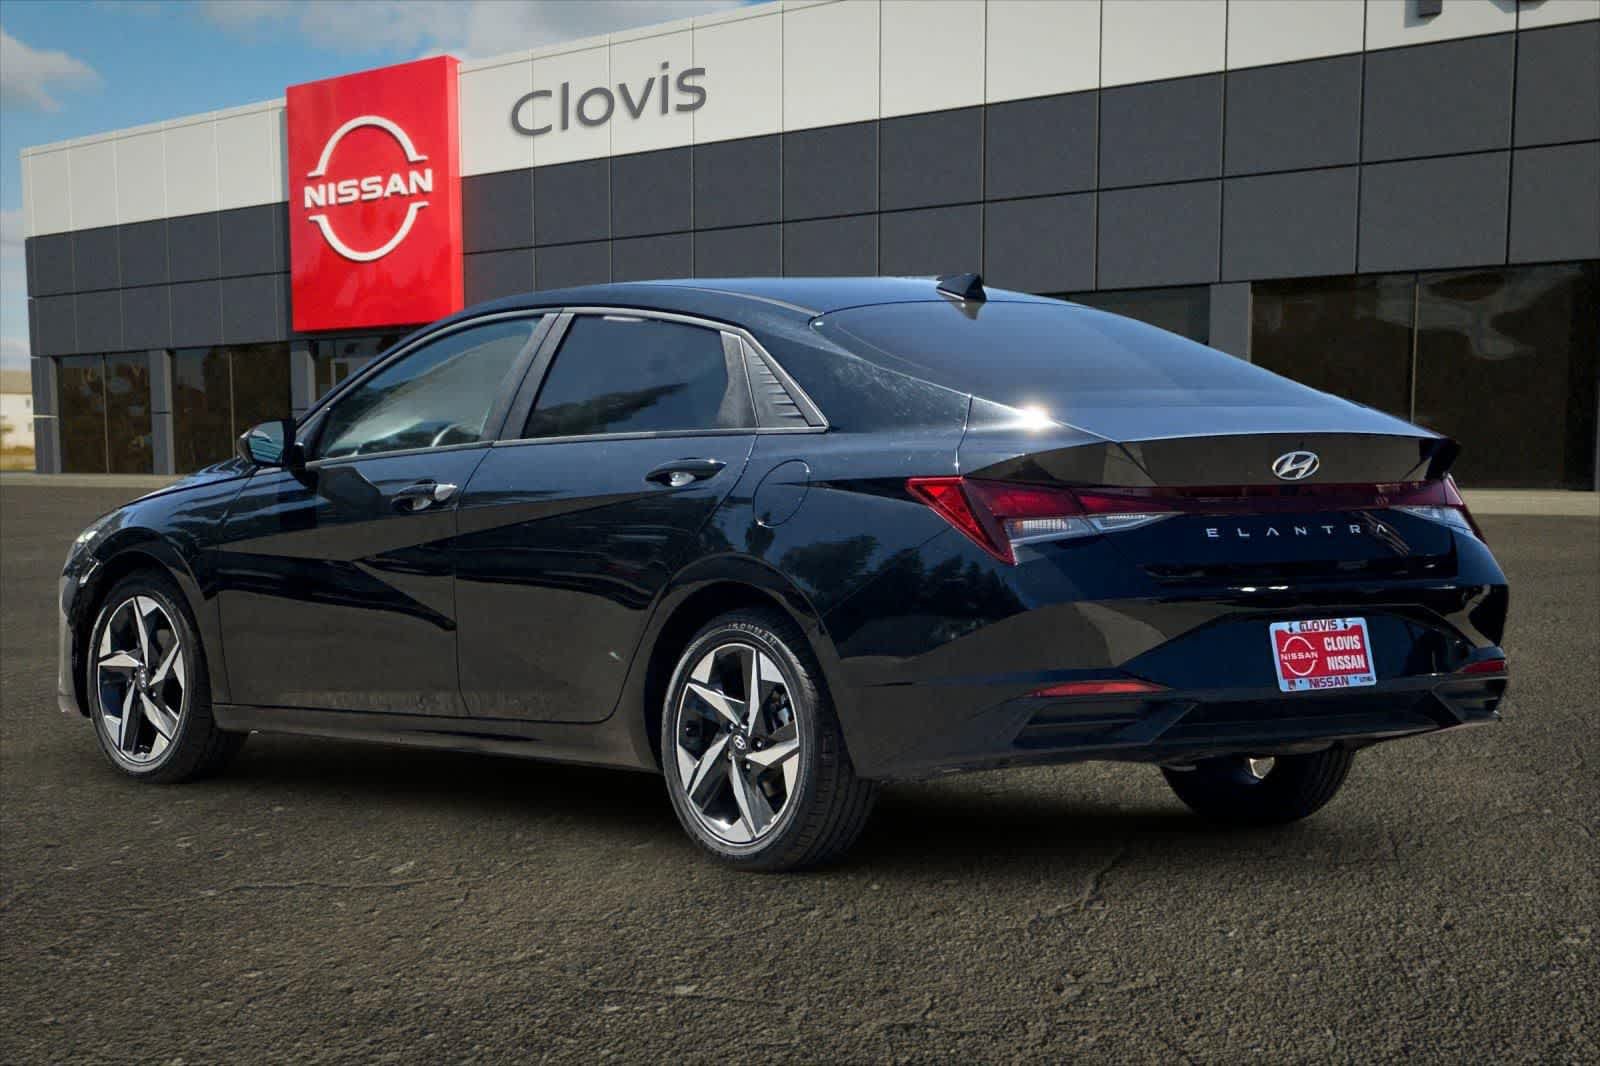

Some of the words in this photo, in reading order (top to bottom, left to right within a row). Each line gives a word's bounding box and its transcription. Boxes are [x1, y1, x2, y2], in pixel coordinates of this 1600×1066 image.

[511, 61, 707, 136] Clovis
[303, 168, 433, 208] NISSAN
[1206, 523, 1388, 538] ELANTRA
[1323, 635, 1361, 651] CLOVIS
[1280, 651, 1318, 660] NISSAN
[1326, 654, 1366, 671] NISSAN
[1309, 676, 1350, 689] NISSAN
